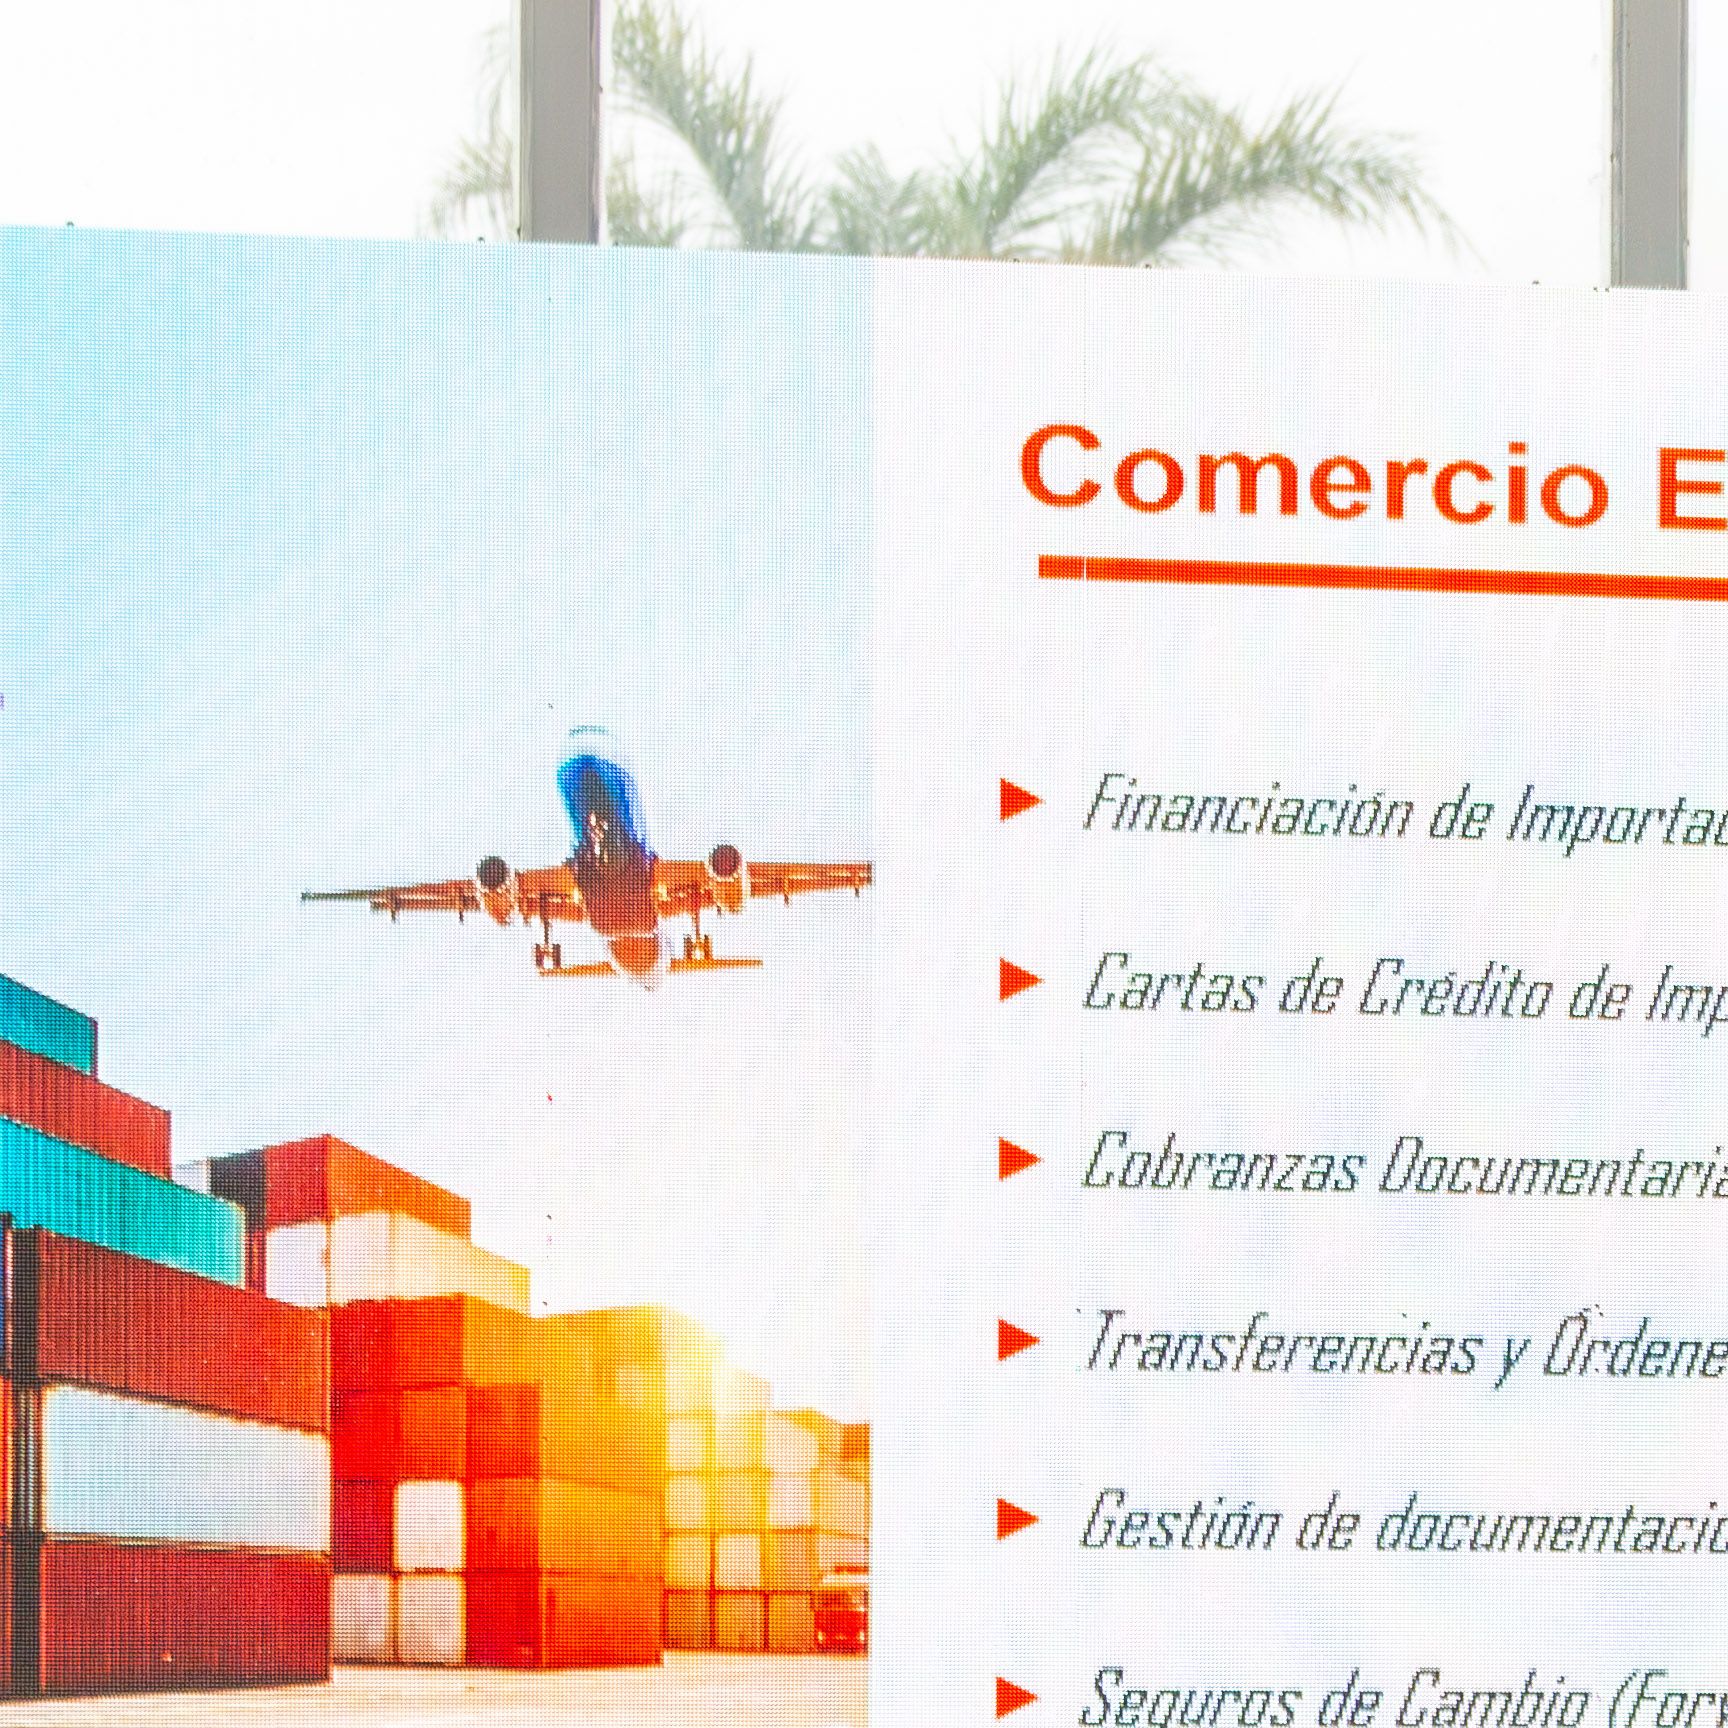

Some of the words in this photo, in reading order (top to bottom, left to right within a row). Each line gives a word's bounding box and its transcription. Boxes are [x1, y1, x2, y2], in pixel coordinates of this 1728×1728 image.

[1020, 424, 1608, 528] Comercio
[1085, 774, 1412, 835] Financiación
[1430, 784, 1493, 838] de
[1085, 954, 1264, 1011] Cartas
[1280, 958, 1342, 1012] de
[1360, 959, 1552, 1016] Crédito
[1570, 966, 1631, 1018] de
[1084, 1132, 1365, 1190] Cobranzas
[1090, 1311, 1483, 1373] Transferencias
[1495, 1338, 1529, 1389] y
[1082, 1490, 1280, 1548] Gestión
[1297, 1494, 1359, 1548] de
[1319, 1670, 1381, 1726] de
[1397, 1670, 1589, 1726] Cambio
